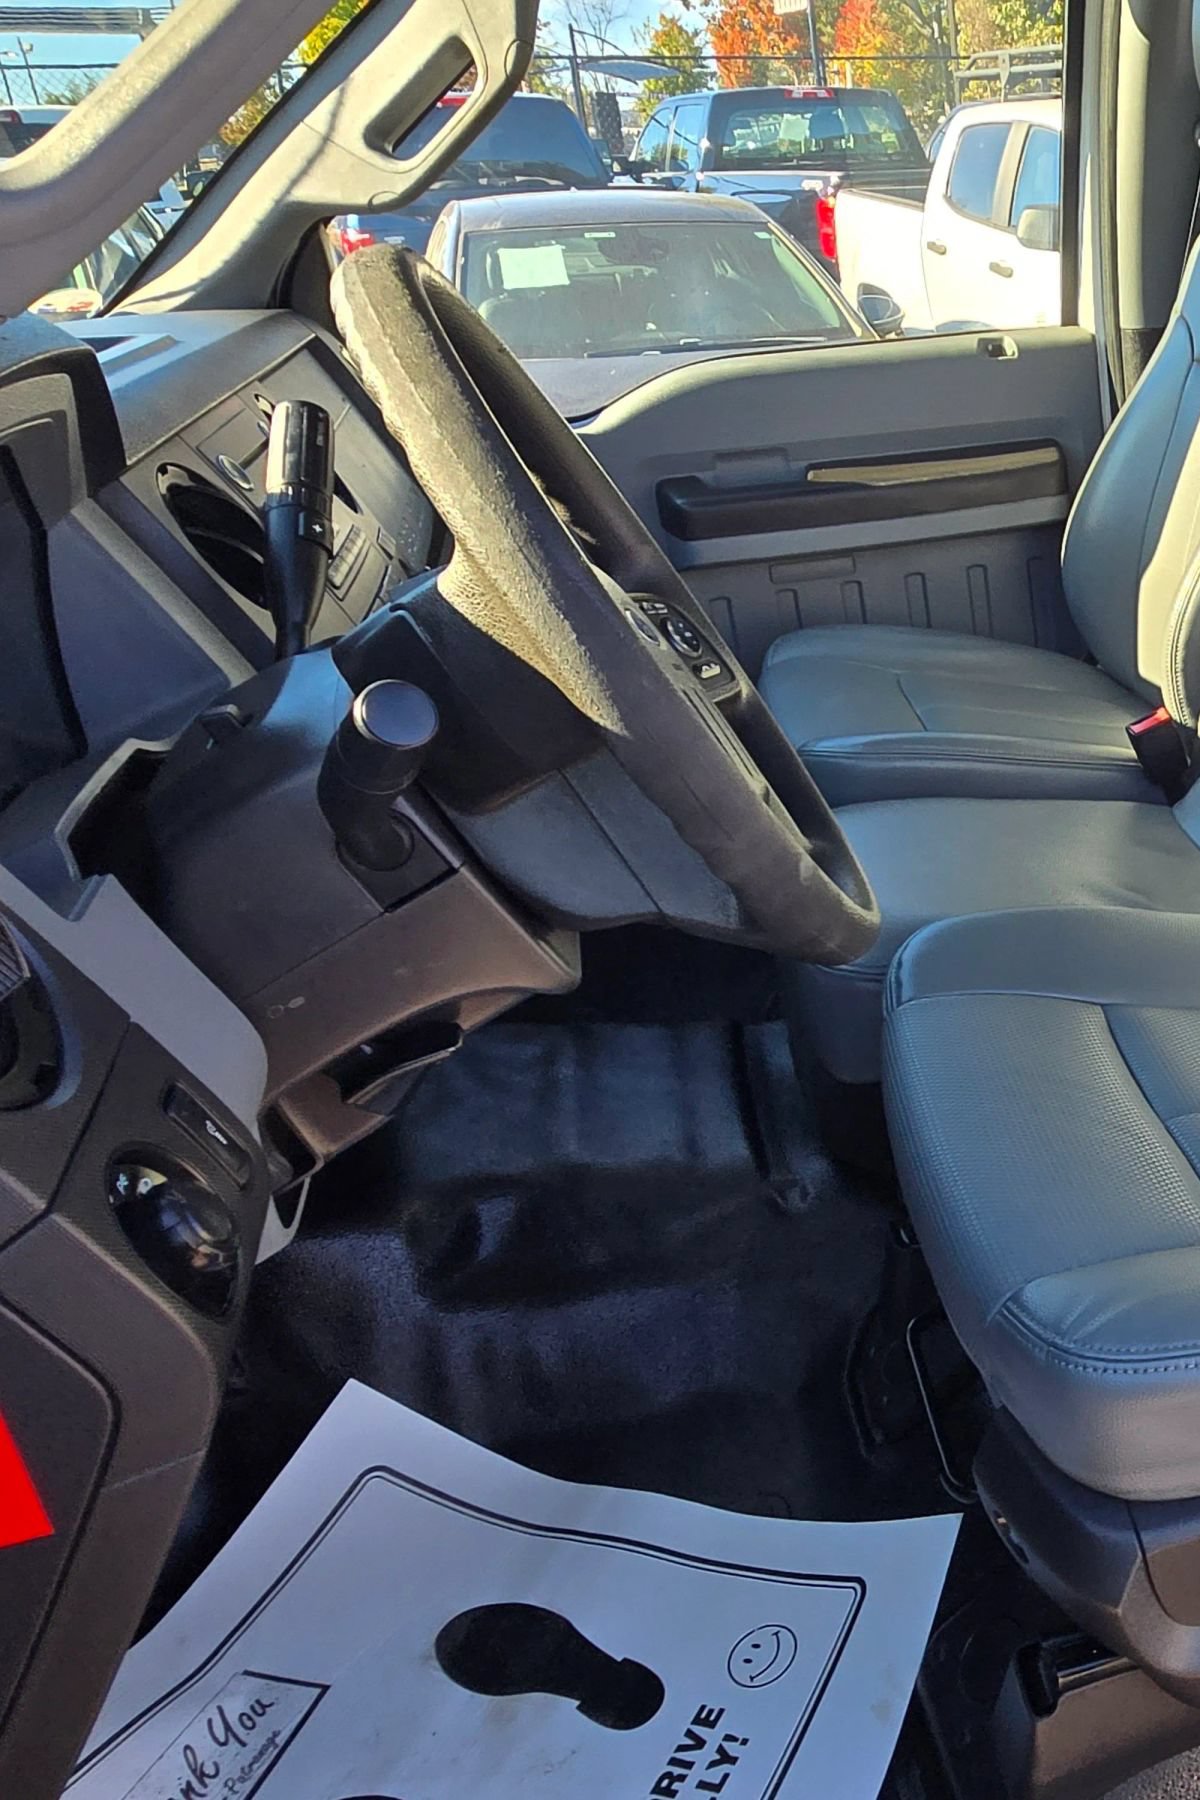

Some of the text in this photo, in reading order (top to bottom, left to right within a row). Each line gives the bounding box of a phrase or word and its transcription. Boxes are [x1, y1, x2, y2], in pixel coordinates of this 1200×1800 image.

[167, 1699, 275, 1800] nk You
[650, 1704, 726, 1800] RIVE
[695, 1733, 750, 1800] LY!
